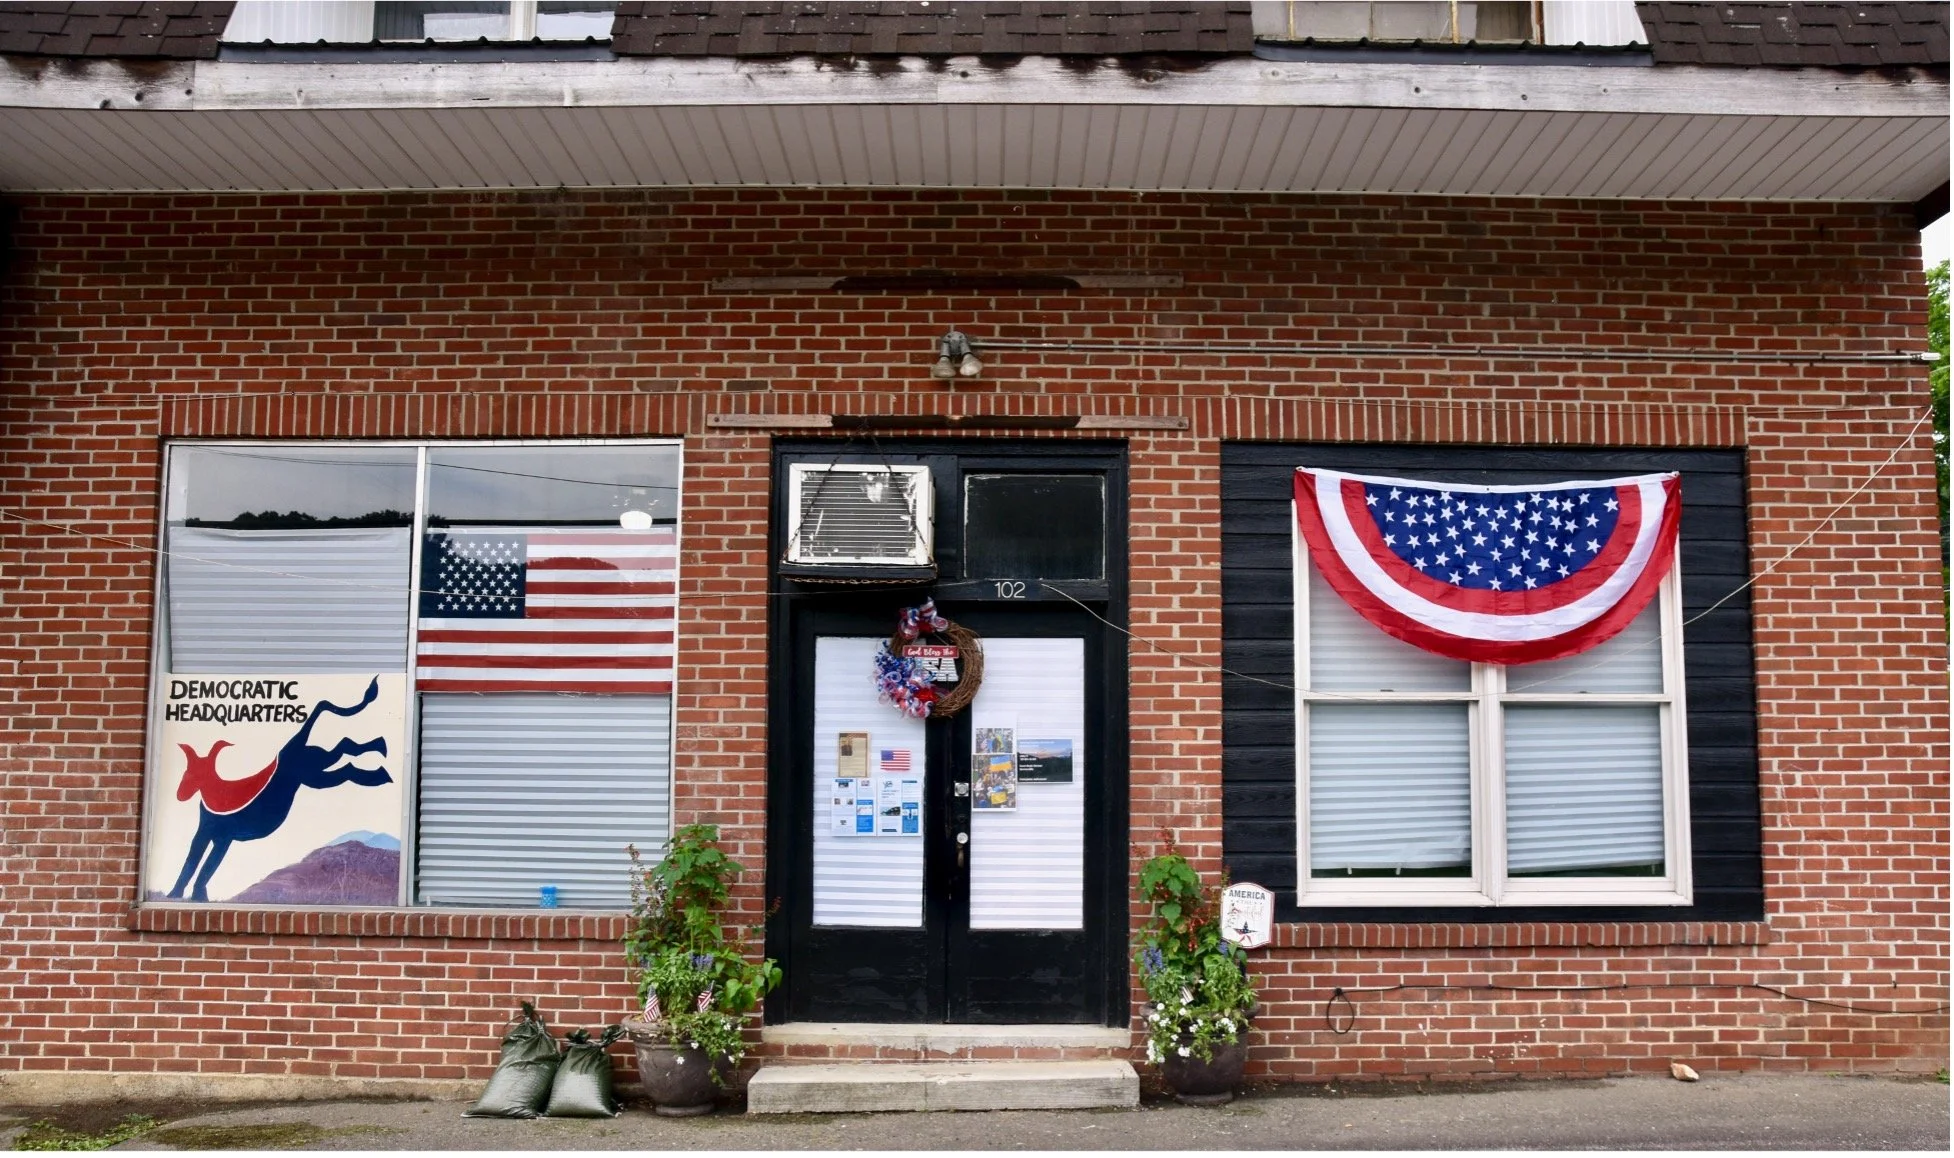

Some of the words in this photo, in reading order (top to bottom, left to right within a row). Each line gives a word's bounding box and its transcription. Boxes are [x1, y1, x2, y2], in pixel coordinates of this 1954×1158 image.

[994, 581, 1026, 599] 102
[907, 647, 922, 656] God
[915, 658, 959, 681] SA
[169, 680, 299, 700] DEMOCRATIC
[165, 703, 308, 726] HEADQUARTERS
[1228, 889, 1266, 900] AMERICA
